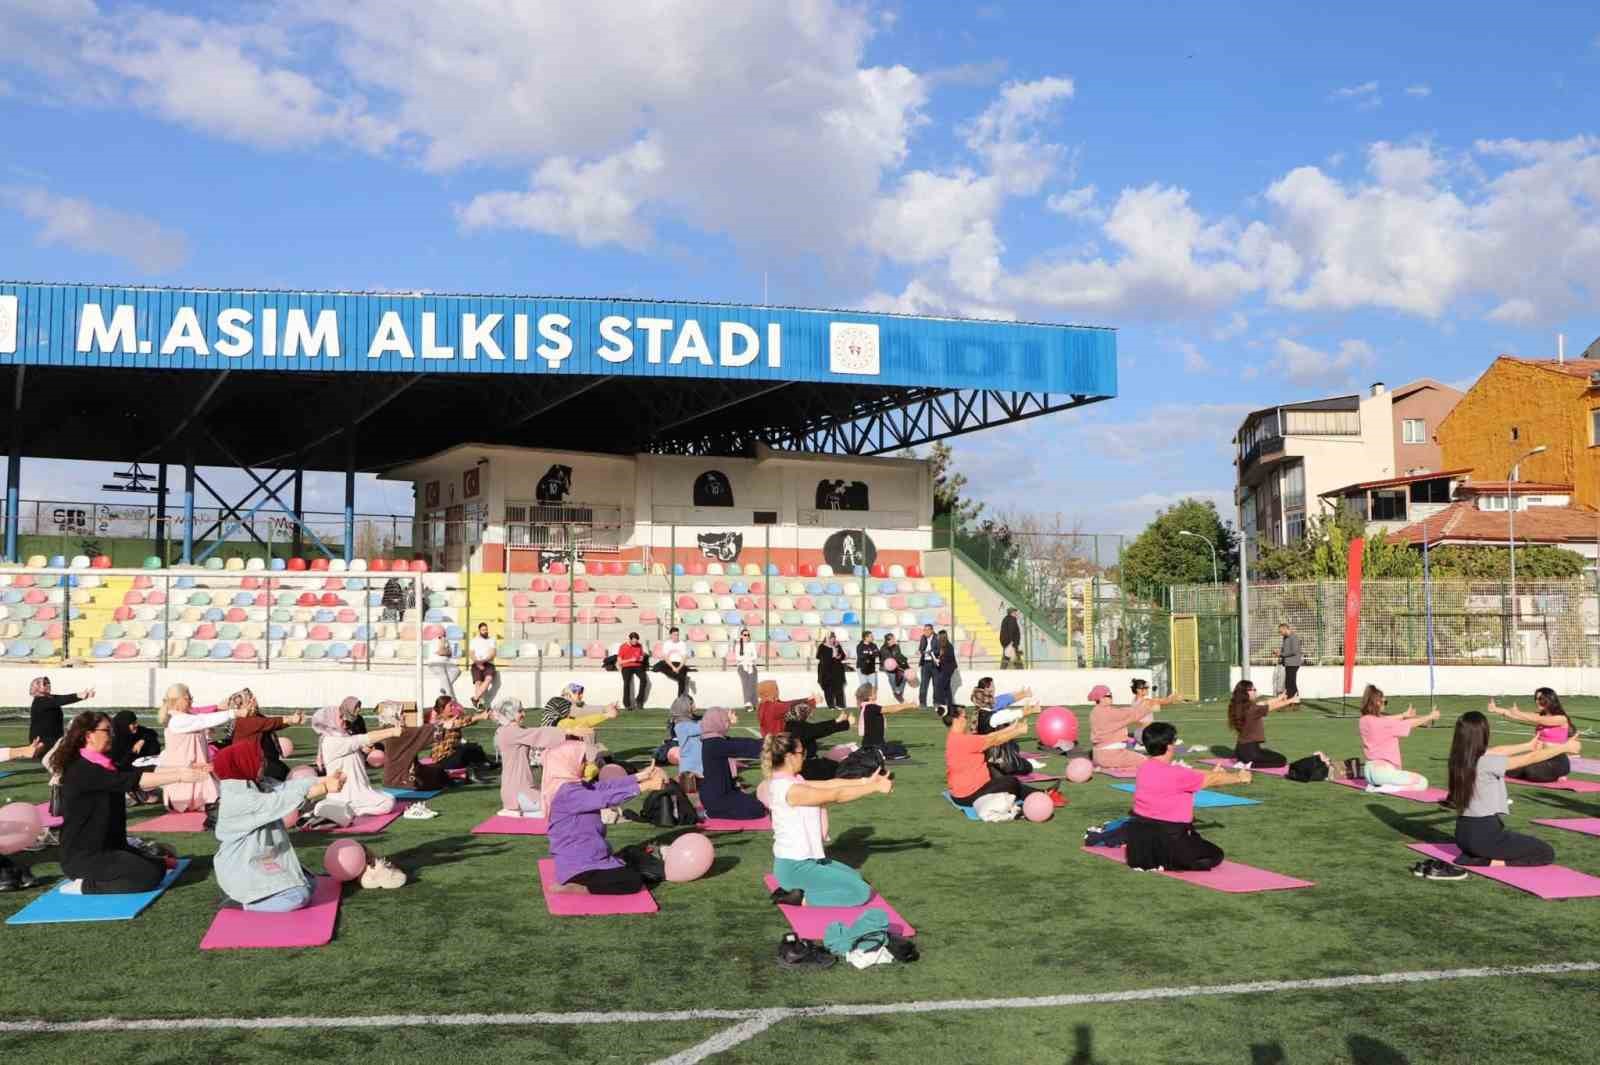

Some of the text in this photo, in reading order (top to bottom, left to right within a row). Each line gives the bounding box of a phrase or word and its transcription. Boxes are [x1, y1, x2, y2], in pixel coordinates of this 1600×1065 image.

[76, 303, 341, 358] M.ASIM
[367, 311, 574, 369] ALKIŞ
[597, 315, 782, 369] STADI
